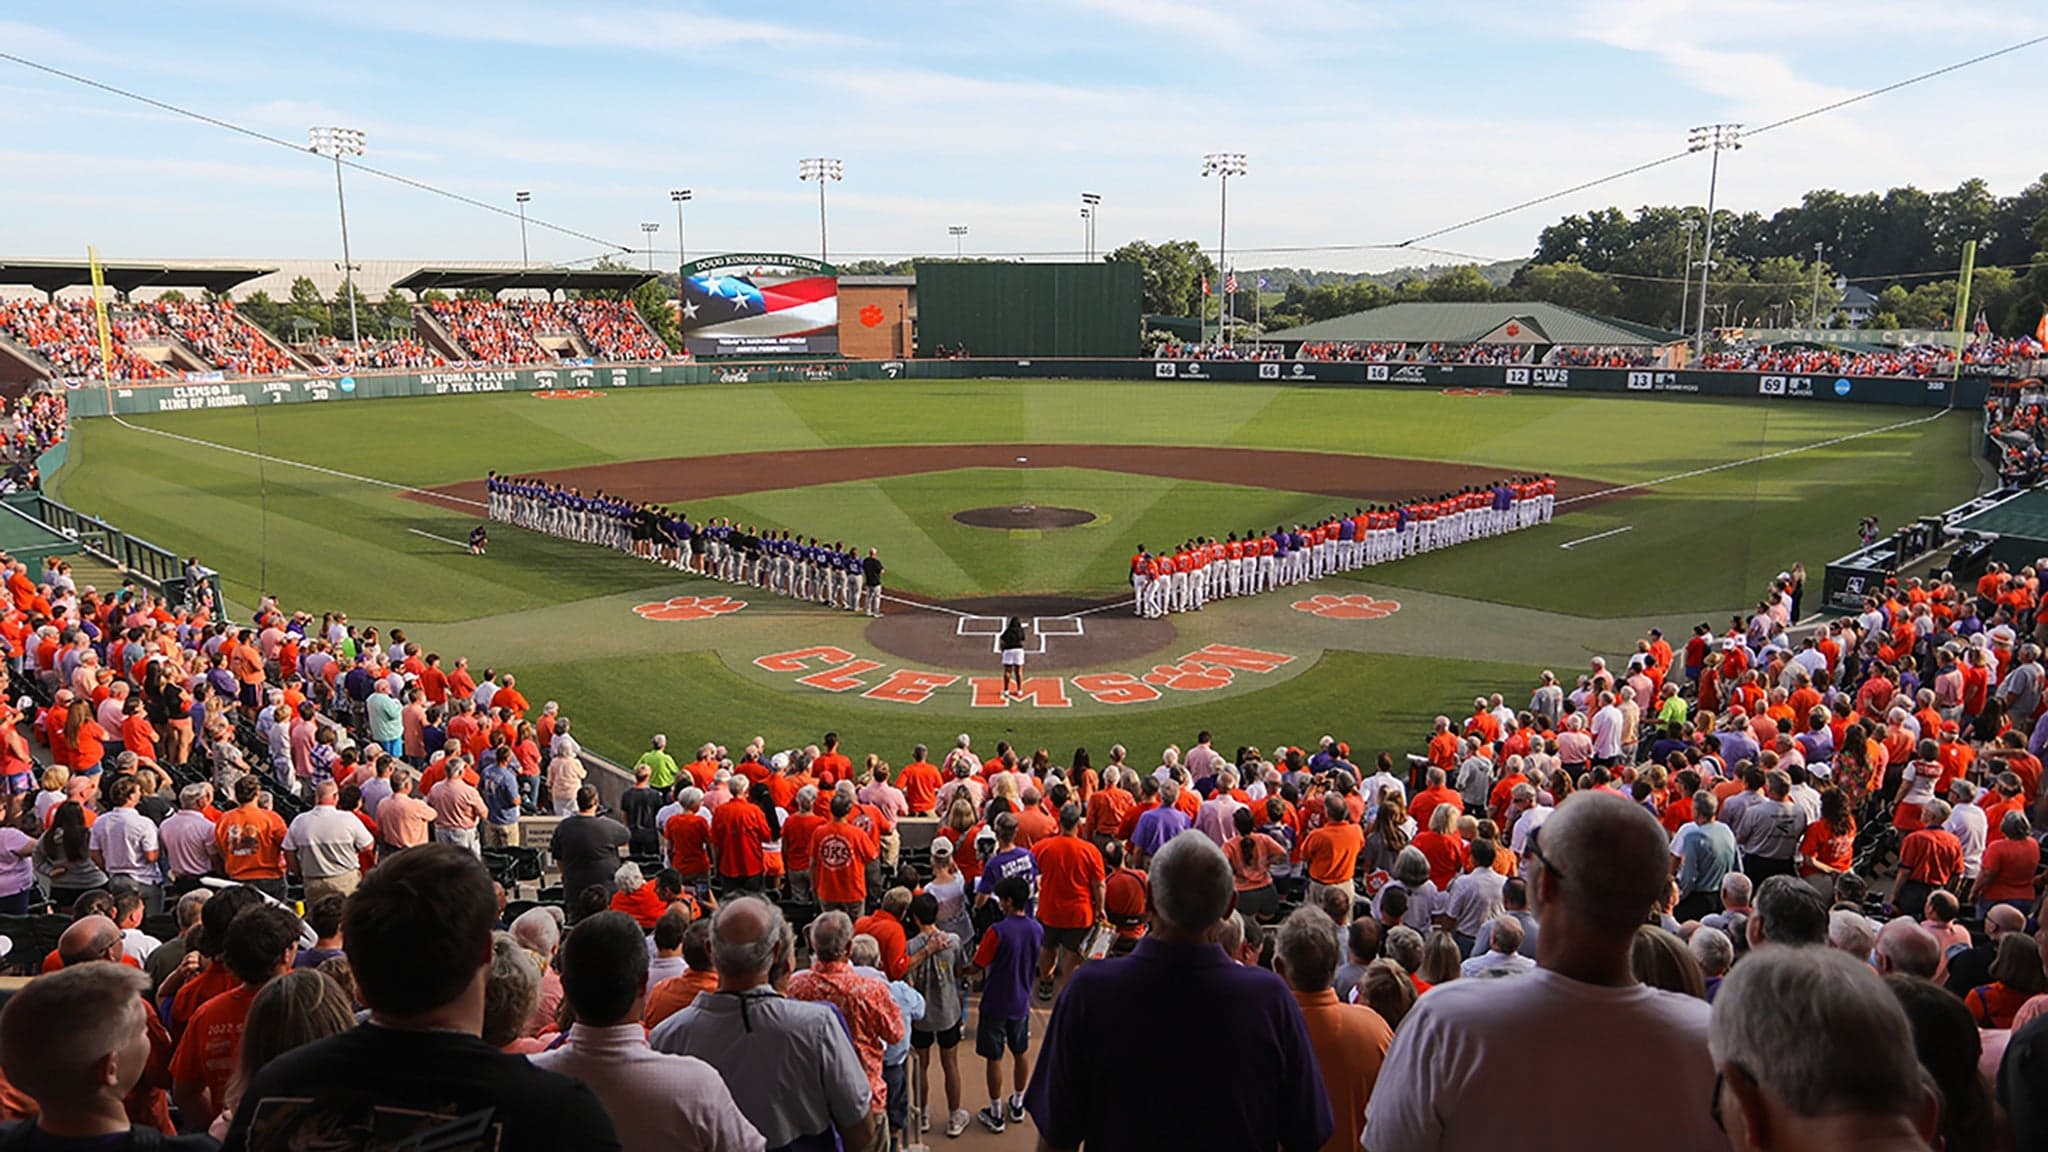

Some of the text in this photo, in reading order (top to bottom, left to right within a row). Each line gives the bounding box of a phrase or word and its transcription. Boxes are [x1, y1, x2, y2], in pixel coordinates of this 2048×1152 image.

[696, 255, 821, 271] DOUG KINGSMORE STADIUM
[888, 368, 898, 378] 7
[1371, 367, 1385, 378] 16
[1395, 366, 1424, 376] ACC
[1510, 371, 1525, 382] 12
[1533, 369, 1569, 382] CWS
[420, 371, 518, 384] NATIONAL PLAYER
[576, 377, 588, 387] 14
[1633, 375, 1648, 386] 13
[436, 381, 503, 393] OF THE YEAR
[1764, 378, 1781, 392] 69
[173, 385, 230, 398] CLEMSON
[273, 392, 281, 403] 3
[160, 394, 248, 411] RING OF HONOR
[208, 1023, 233, 1035] 2022
